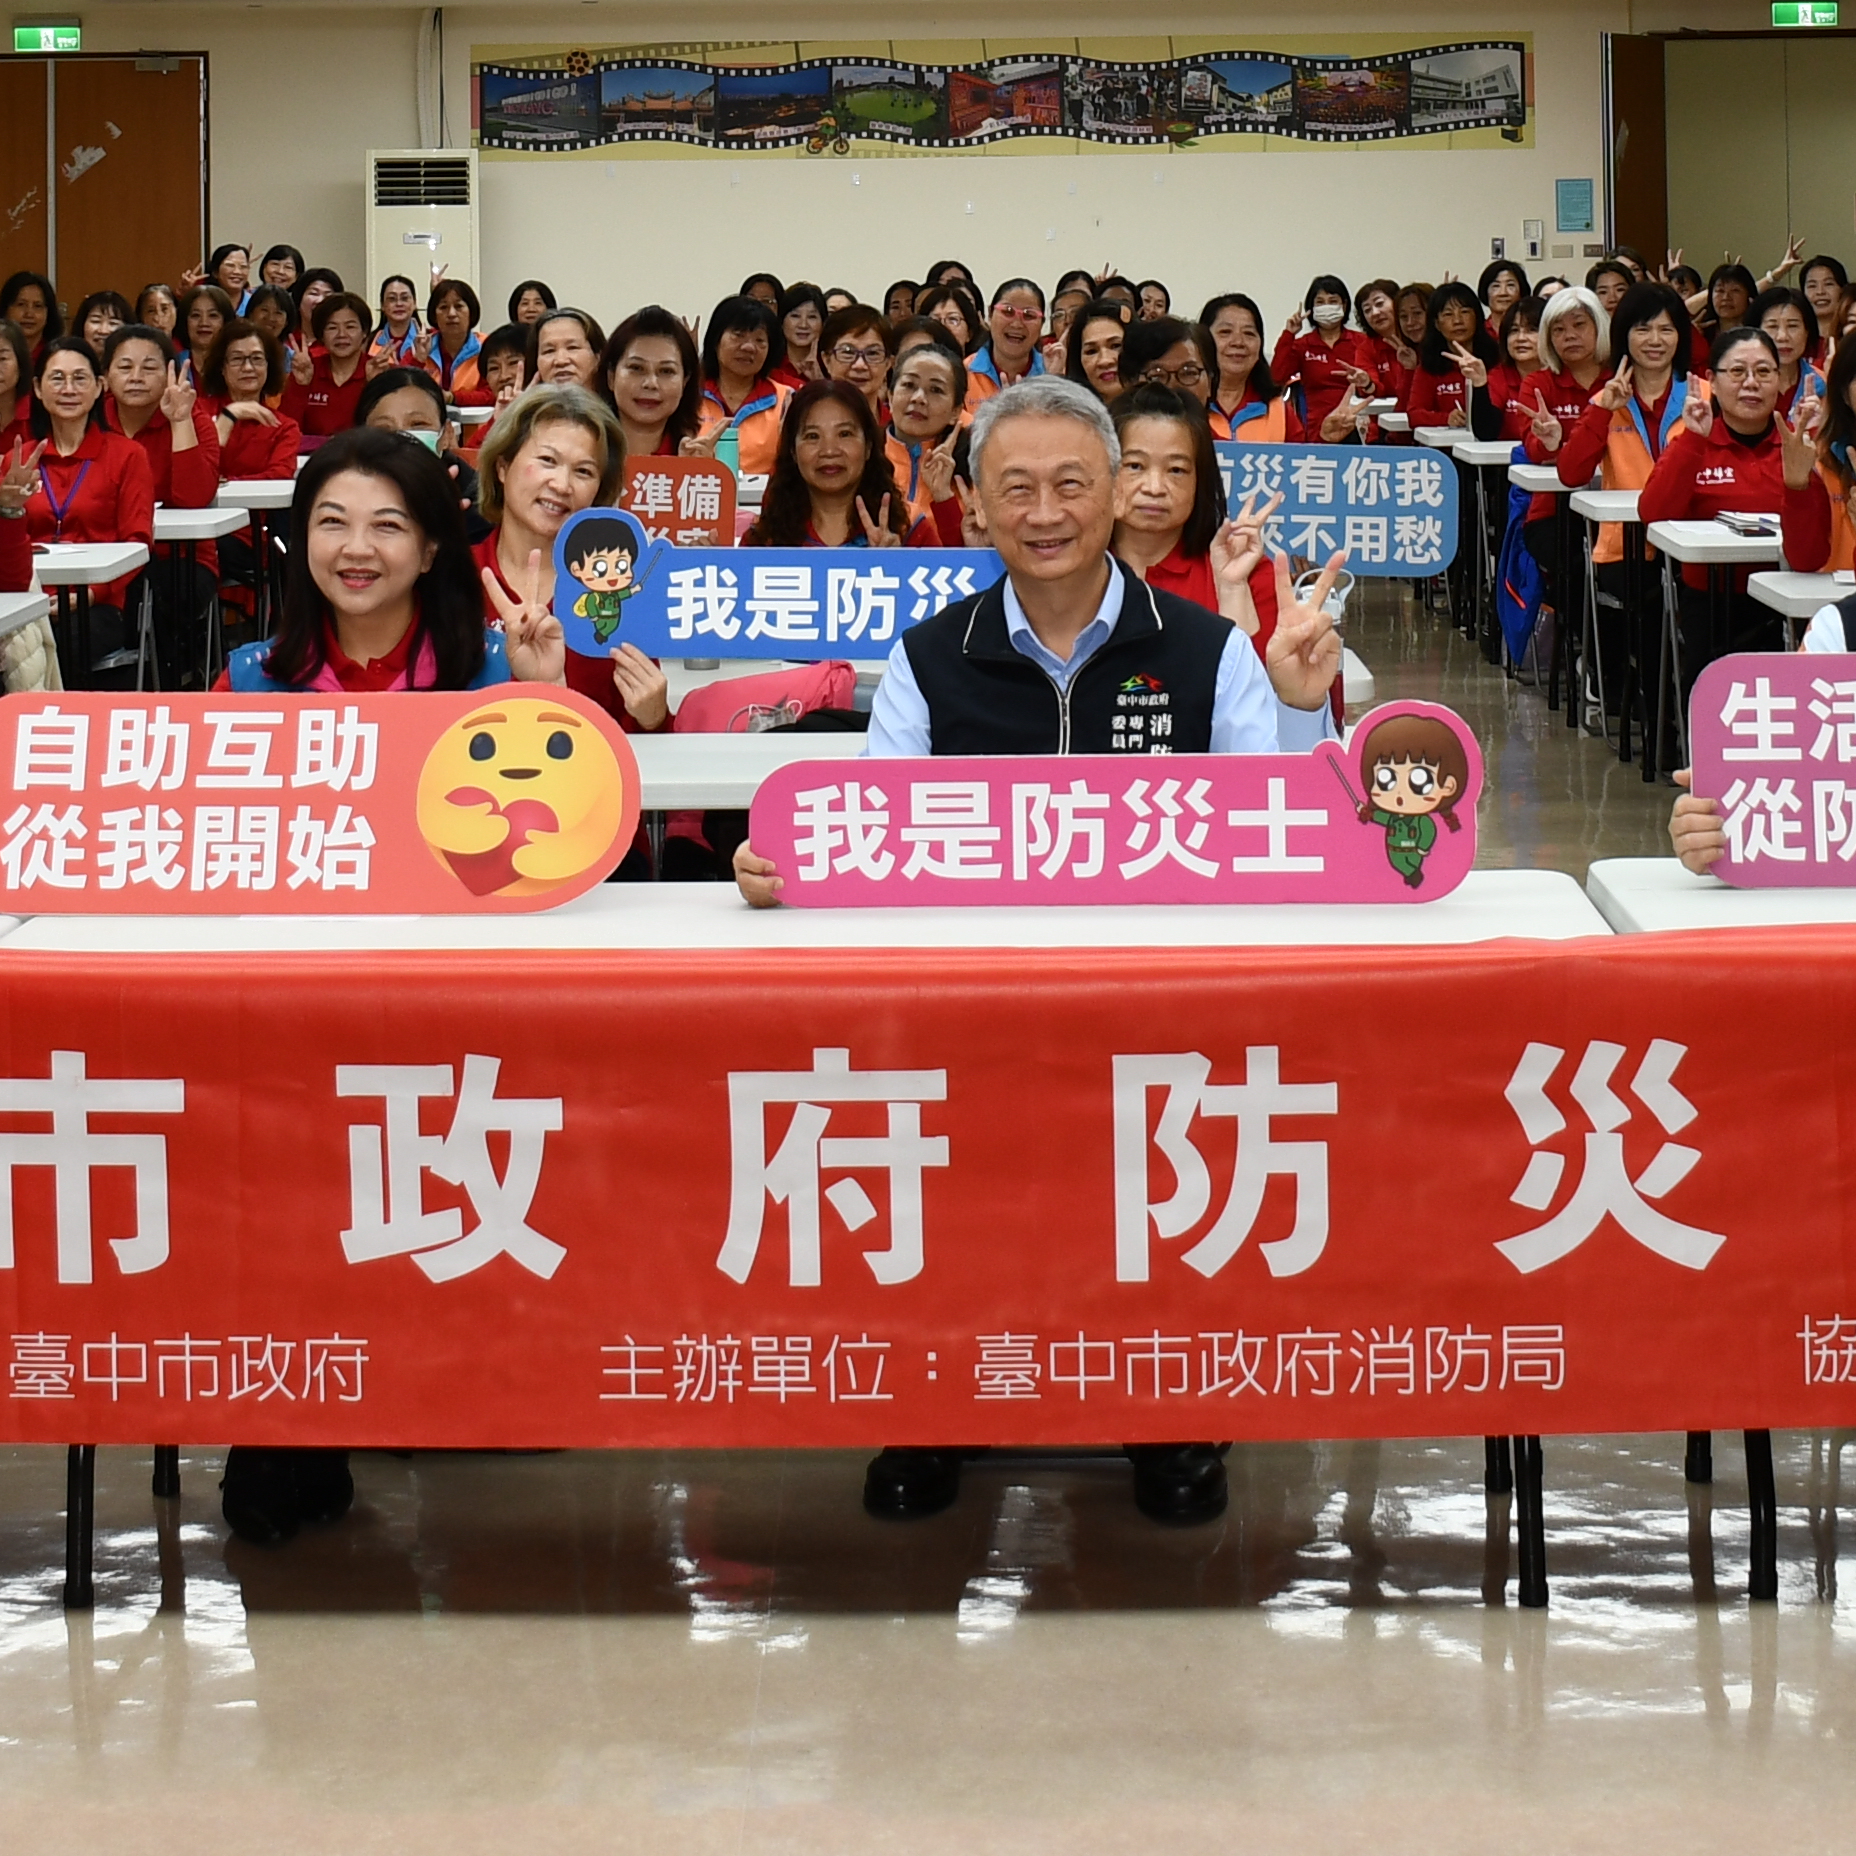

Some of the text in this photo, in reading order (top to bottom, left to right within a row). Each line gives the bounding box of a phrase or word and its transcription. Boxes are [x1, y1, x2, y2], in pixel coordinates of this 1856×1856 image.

[621, 472, 722, 521] 準備
[668, 566, 977, 642] 我是防災
[1117, 692, 1170, 707] 臺中市政府
[13, 705, 379, 792] 自助互助
[0, 803, 377, 892] 從我開始
[792, 778, 1329, 882] 我是防災士
[598, 1324, 1566, 1403] 主辦單位：臺中市政府消防局
